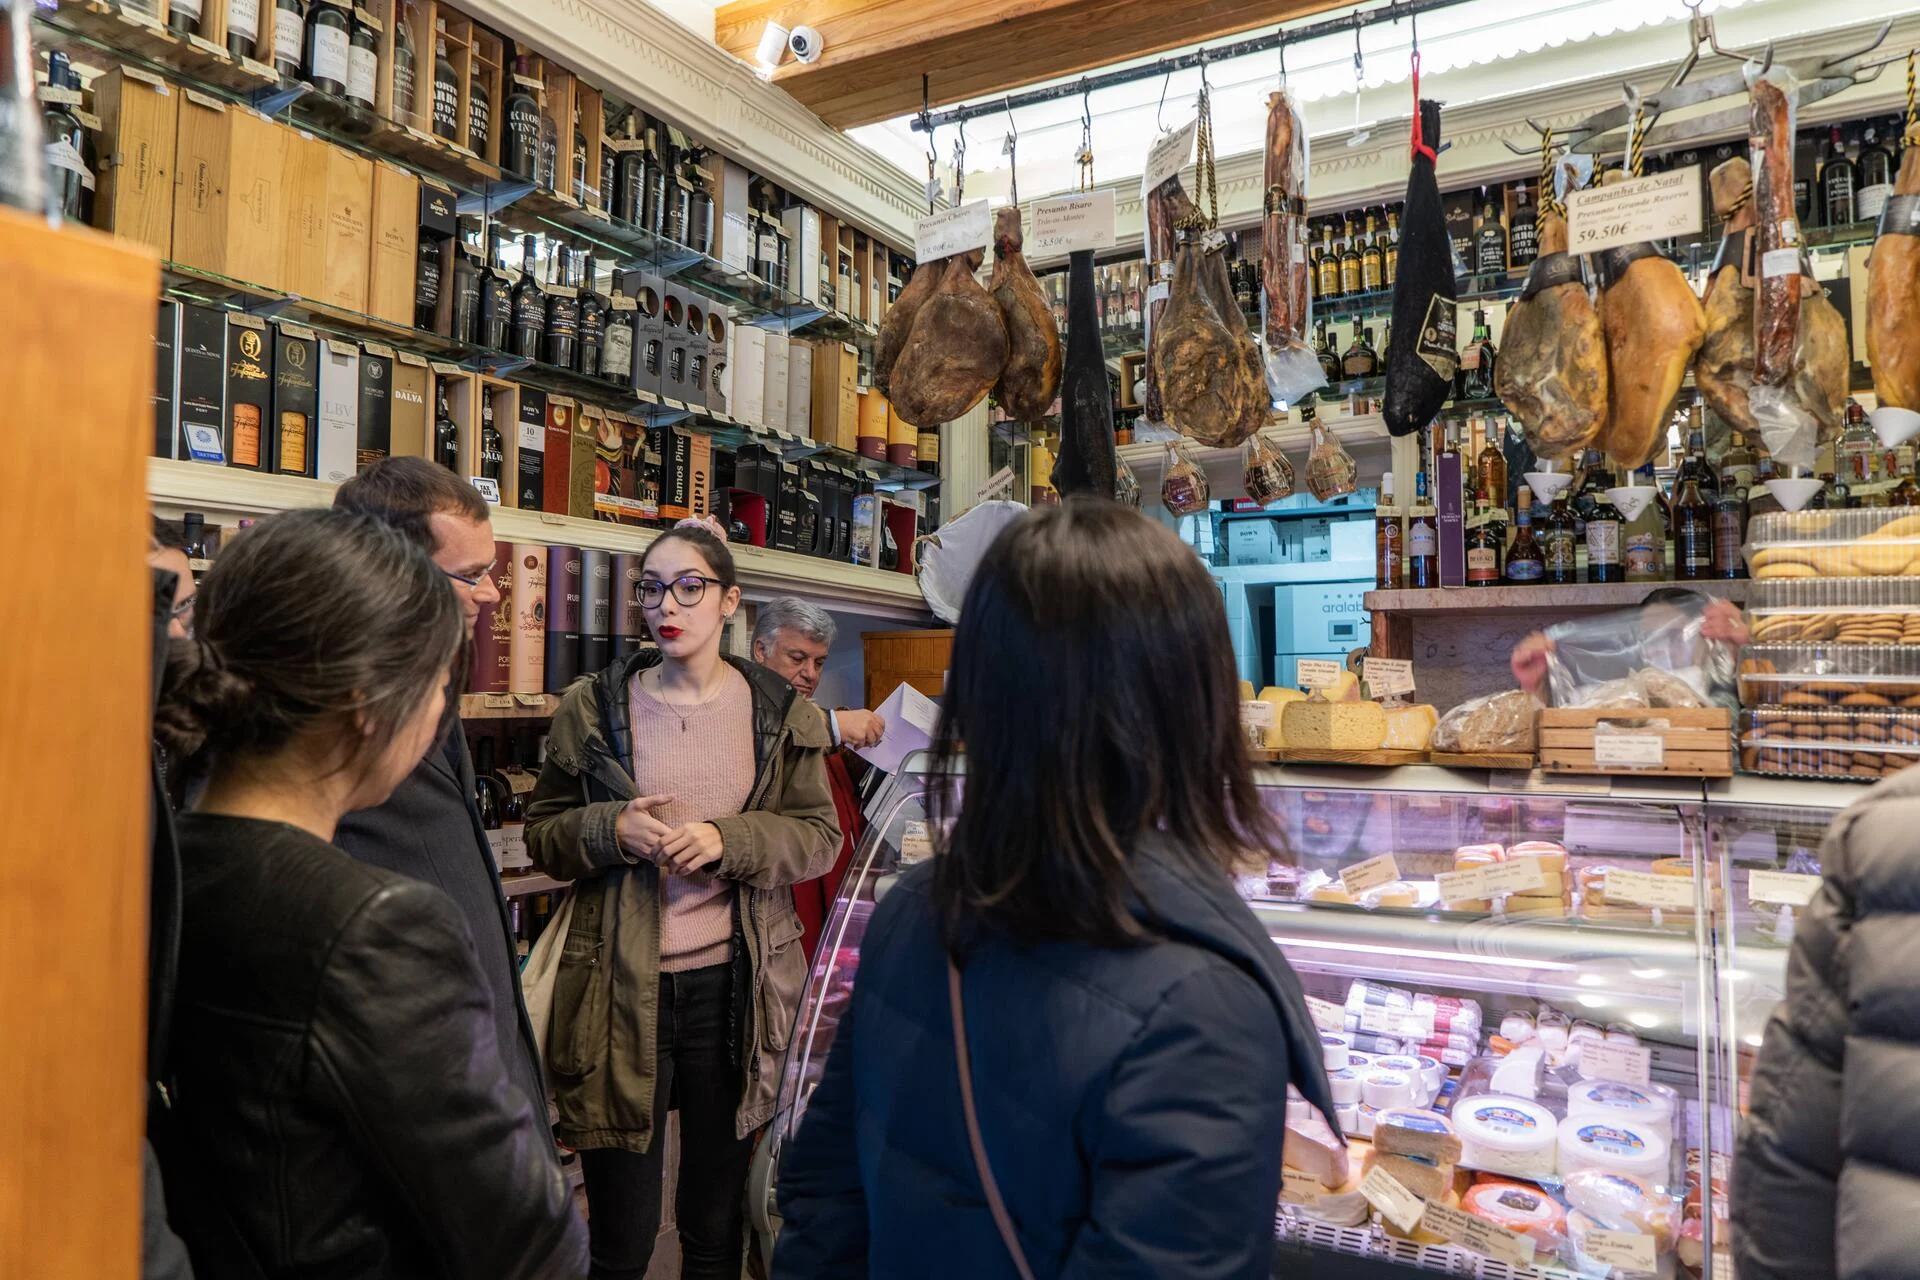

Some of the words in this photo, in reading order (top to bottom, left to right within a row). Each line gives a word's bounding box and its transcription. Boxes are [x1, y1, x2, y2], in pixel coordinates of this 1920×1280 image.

[510, 122, 537, 135] VINT
[1577, 186, 1634, 204] Campanha
[1637, 182, 1650, 193] de
[1654, 174, 1684, 187] Natal
[1036, 205, 1068, 216] Presunto
[1577, 206, 1615, 219] Presunto
[395, 390, 423, 404] DALVA
[526, 427, 535, 436] 10
[674, 464, 685, 504] Ramos
